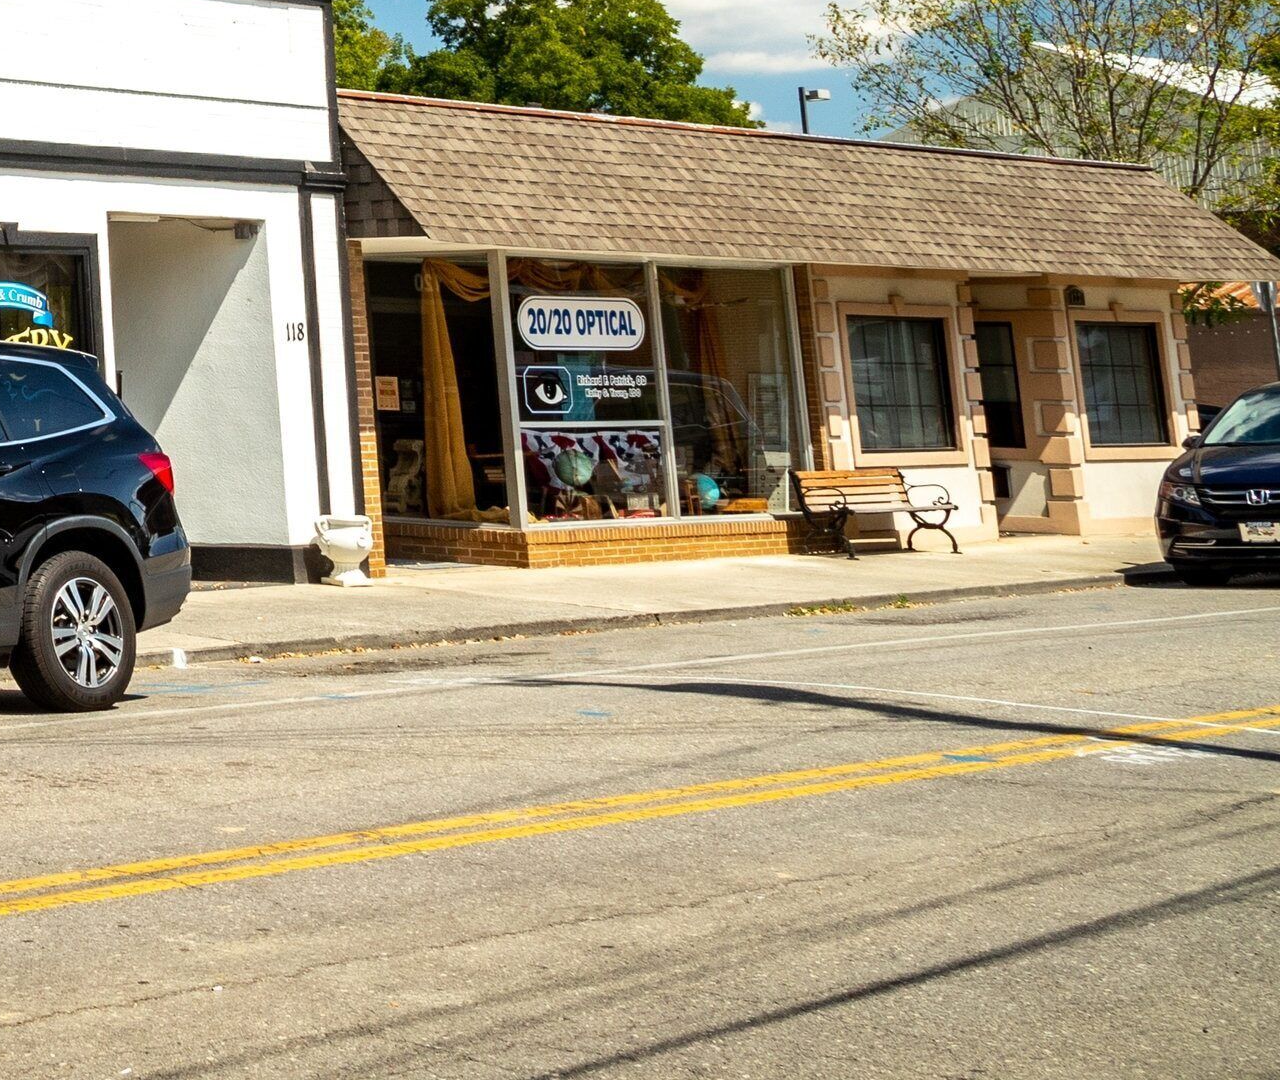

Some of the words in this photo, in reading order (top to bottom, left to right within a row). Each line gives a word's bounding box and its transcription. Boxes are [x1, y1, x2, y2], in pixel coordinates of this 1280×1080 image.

[8, 290, 43, 309] Crumb
[527, 307, 572, 335] 20/20
[576, 309, 637, 336] OPTICAL
[286, 322, 305, 341] 118
[576, 375, 602, 386] Richard
